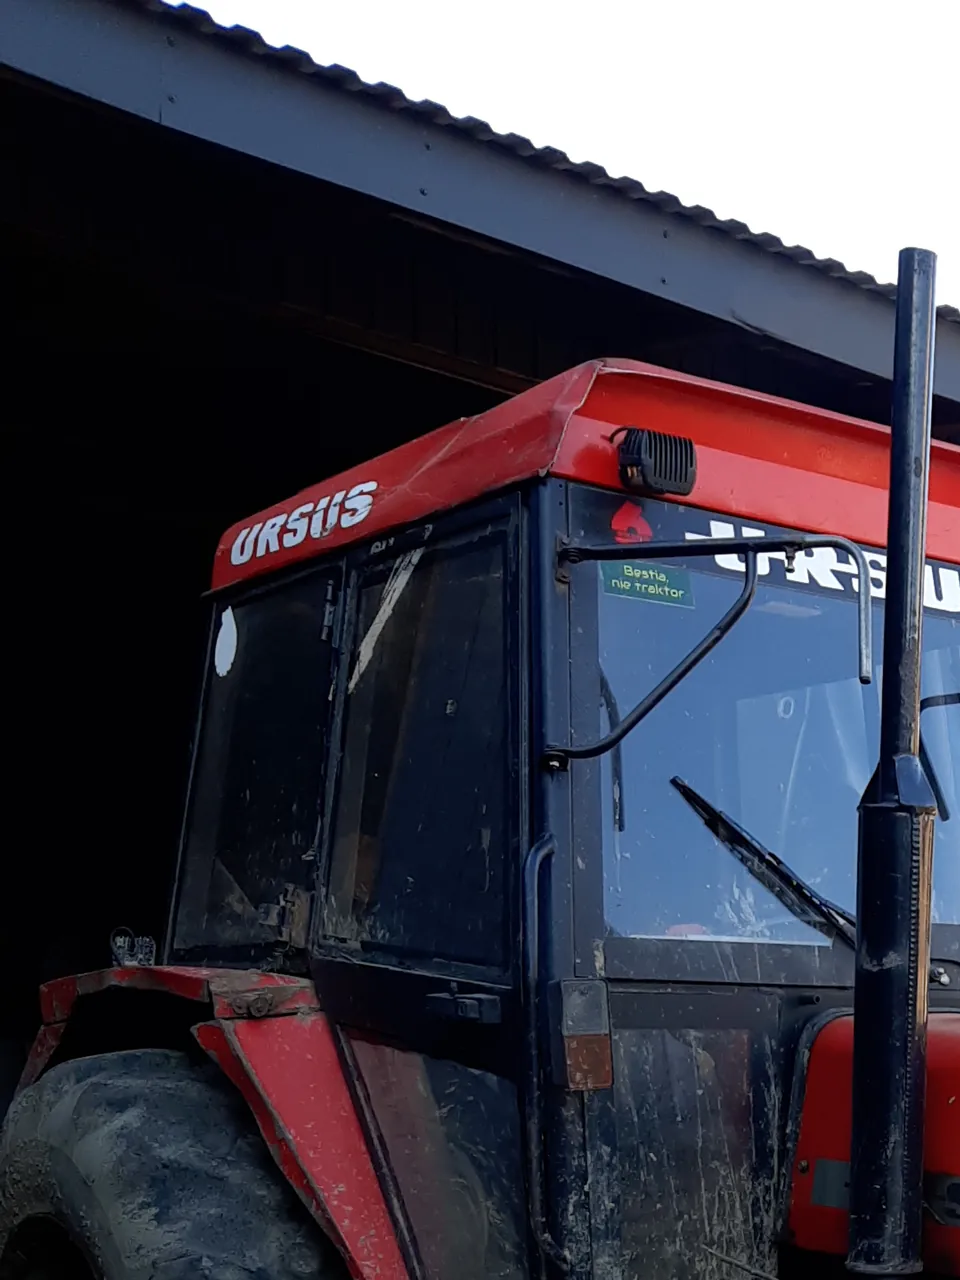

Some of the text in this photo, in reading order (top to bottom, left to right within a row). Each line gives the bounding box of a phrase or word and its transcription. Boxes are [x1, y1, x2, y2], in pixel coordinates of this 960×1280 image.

[230, 481, 378, 566] URSUS
[623, 564, 670, 583] Bestia,
[611, 578, 685, 599] nie traktor
